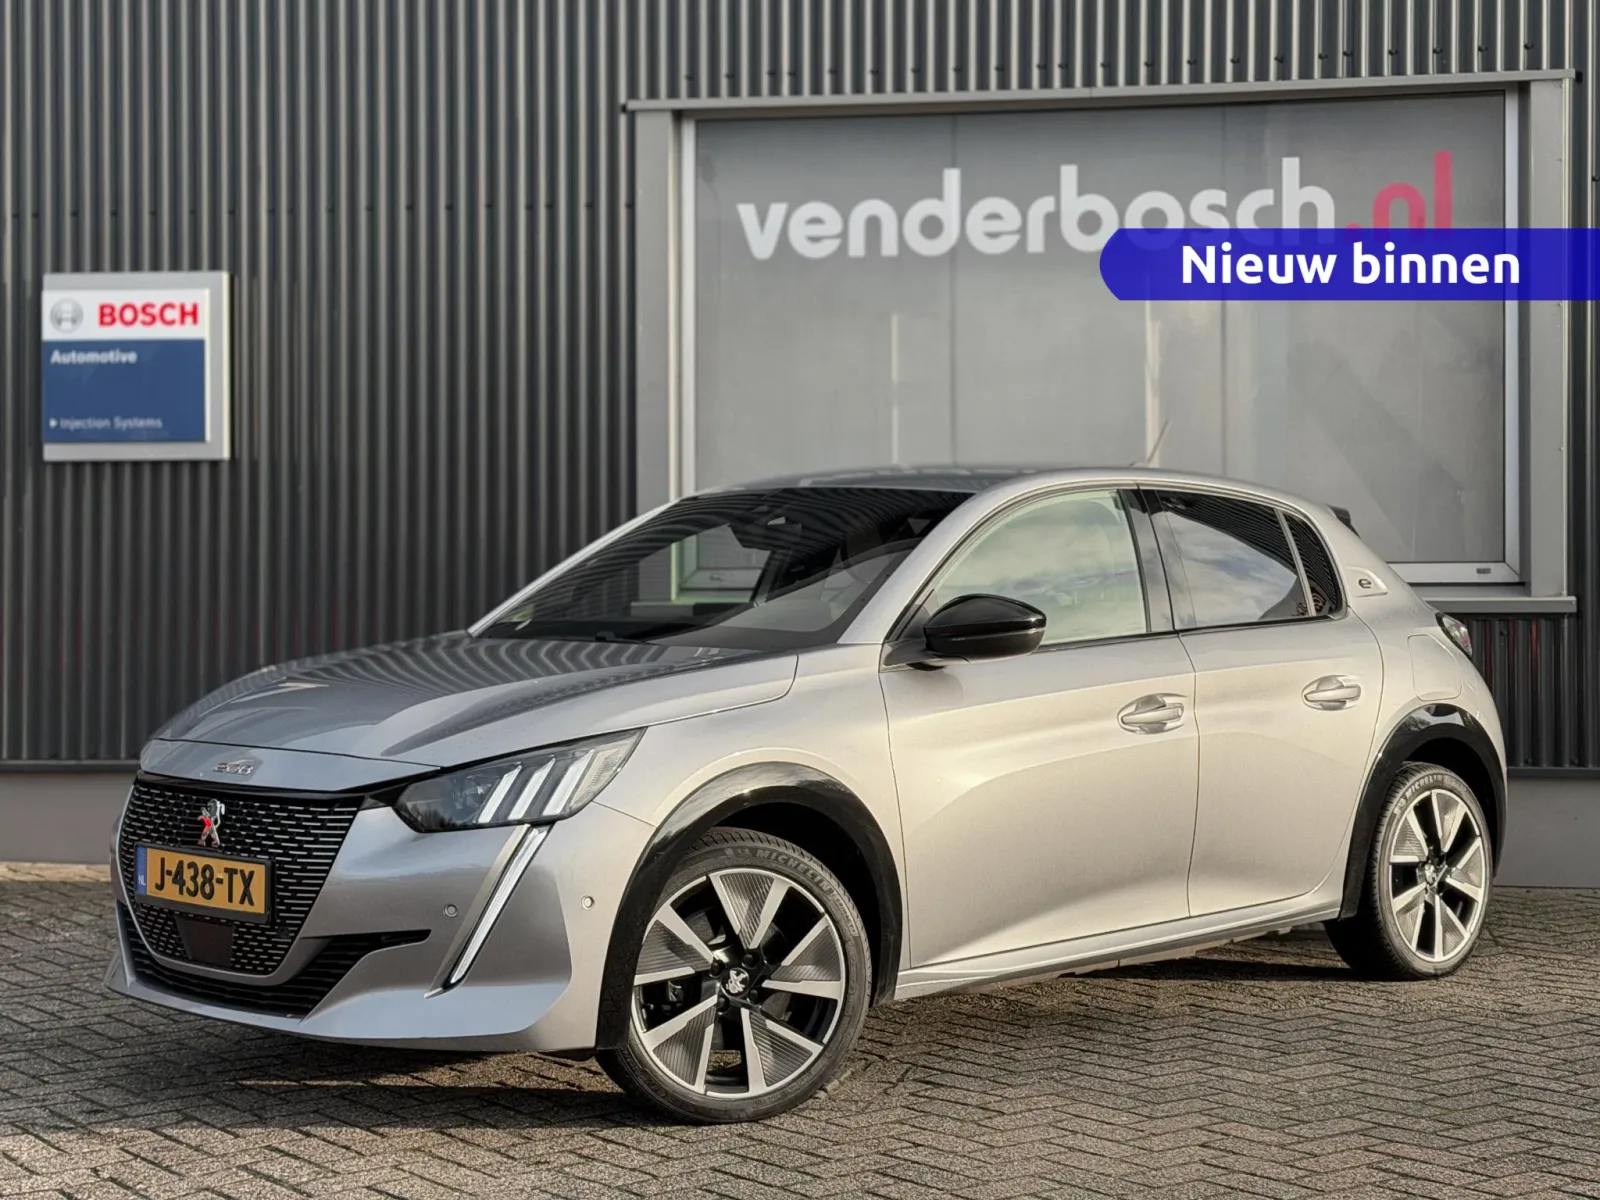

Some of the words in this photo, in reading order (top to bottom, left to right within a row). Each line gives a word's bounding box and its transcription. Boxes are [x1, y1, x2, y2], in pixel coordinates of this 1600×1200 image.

[736, 151, 1453, 260] venderbosch.nl
[98, 302, 198, 326] BOSCH
[51, 349, 137, 364] Automotive
[60, 417, 110, 431] Injection
[114, 416, 163, 431] Systems
[138, 874, 146, 886] NL
[155, 857, 255, 906] J-438-TX
[756, 849, 834, 893] MICHELIN
